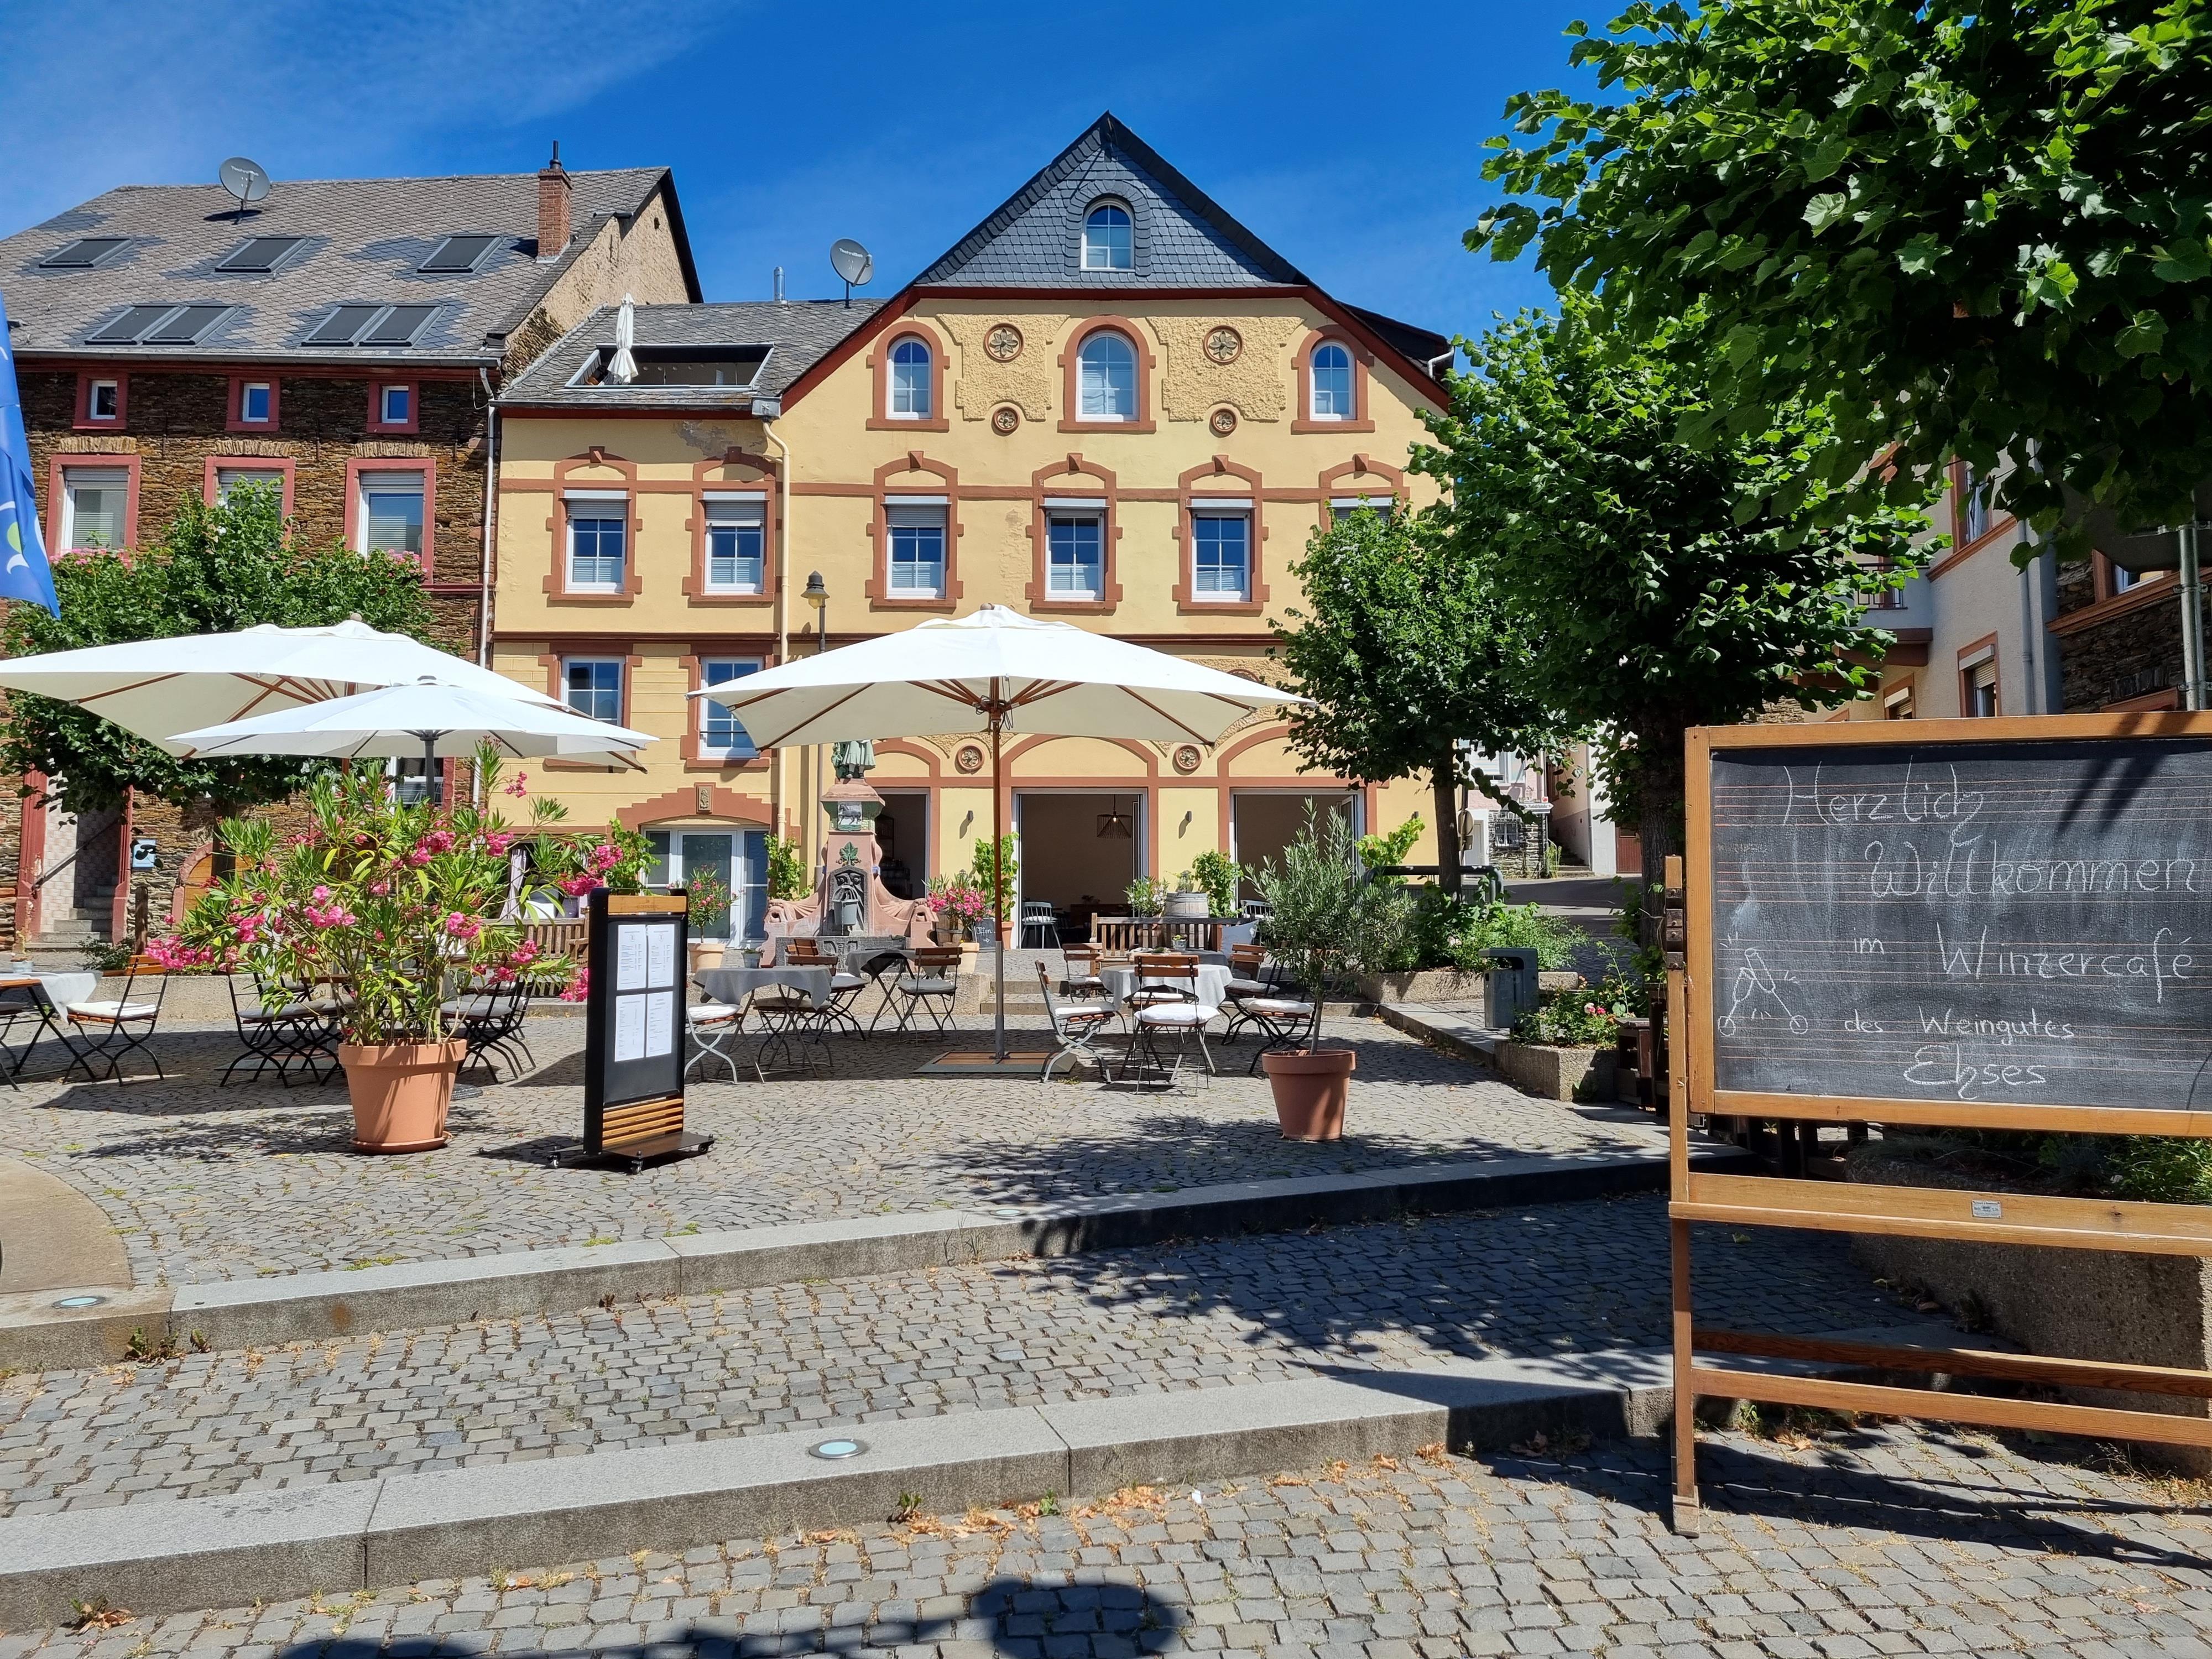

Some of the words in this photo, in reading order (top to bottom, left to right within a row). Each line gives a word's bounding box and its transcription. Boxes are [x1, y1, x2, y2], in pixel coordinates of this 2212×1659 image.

[1783, 754, 1984, 847] Herzlich
[1865, 838, 2199, 898] Willkommen
[975, 926, 993, 936] Offen
[1854, 927, 1885, 955] im
[1936, 921, 2192, 1004] Winzercafé
[1844, 1009, 1884, 1033] des
[1918, 1005, 2074, 1046] Weingutes
[1903, 1043, 2047, 1100] Ehses
